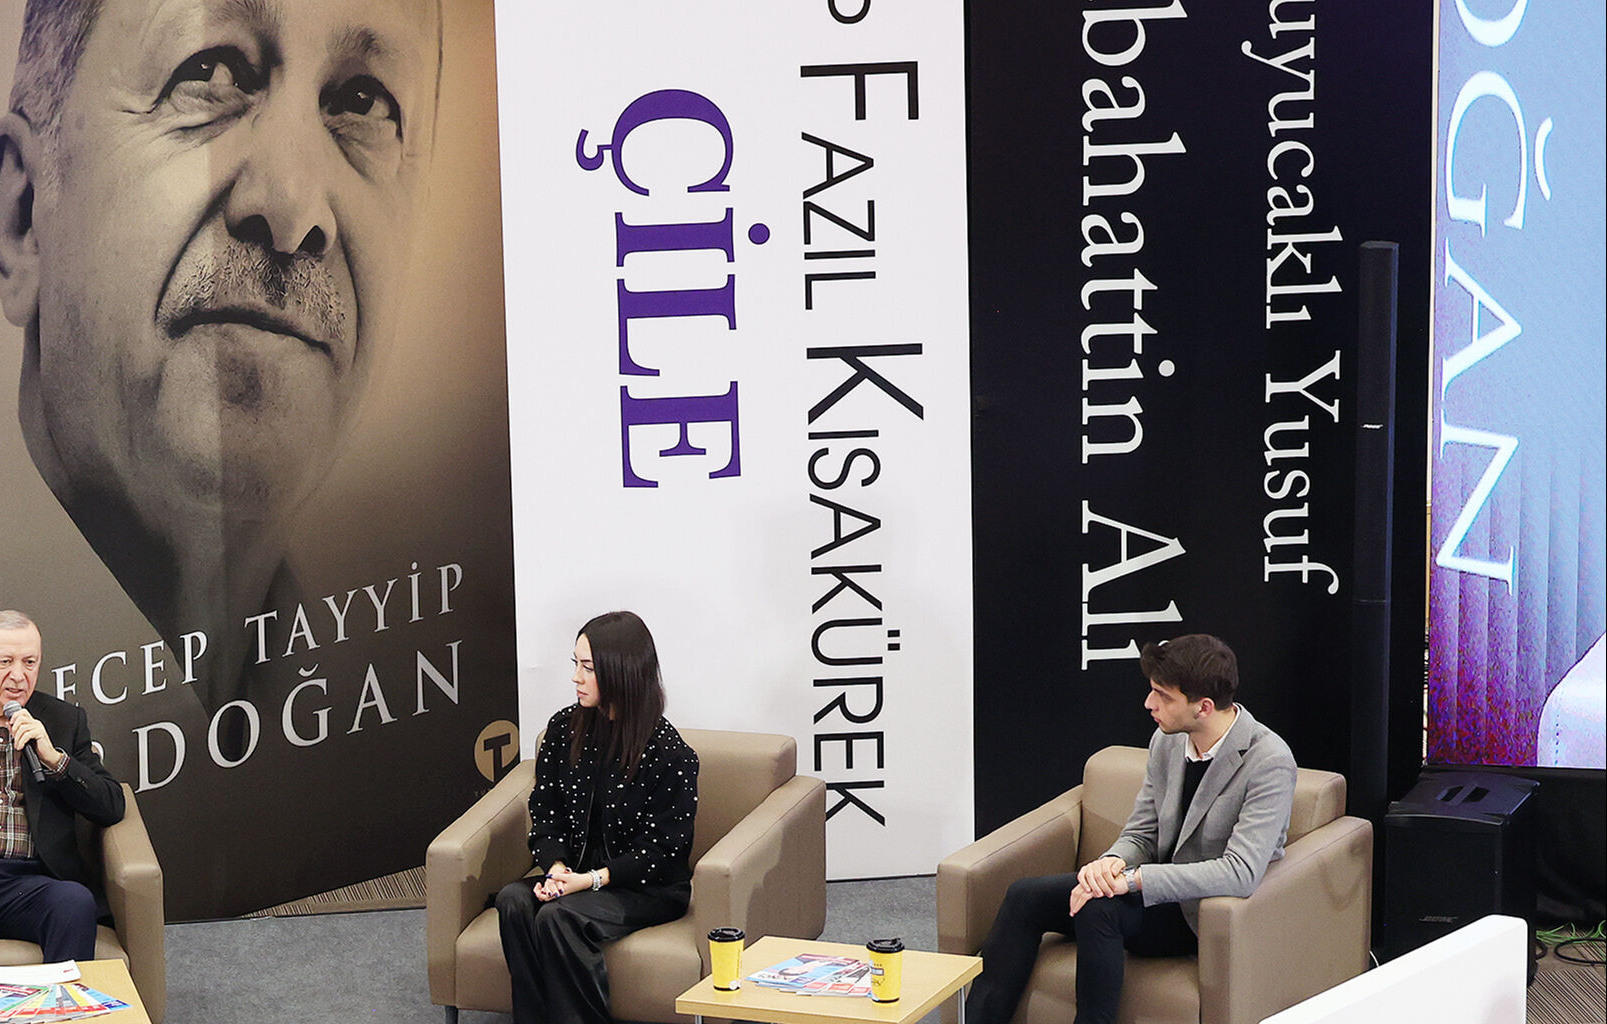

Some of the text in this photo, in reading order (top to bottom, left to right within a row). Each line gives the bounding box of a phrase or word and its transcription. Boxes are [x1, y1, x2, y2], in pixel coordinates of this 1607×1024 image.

[576, 89, 770, 488] ÇİLE
[800, 61, 924, 827] FAZIL KISAKÜREK
[1263, 350, 1342, 596] Yusuf
[91, 640, 463, 794] DOĞAN
[244, 561, 464, 664] TAYYİP
